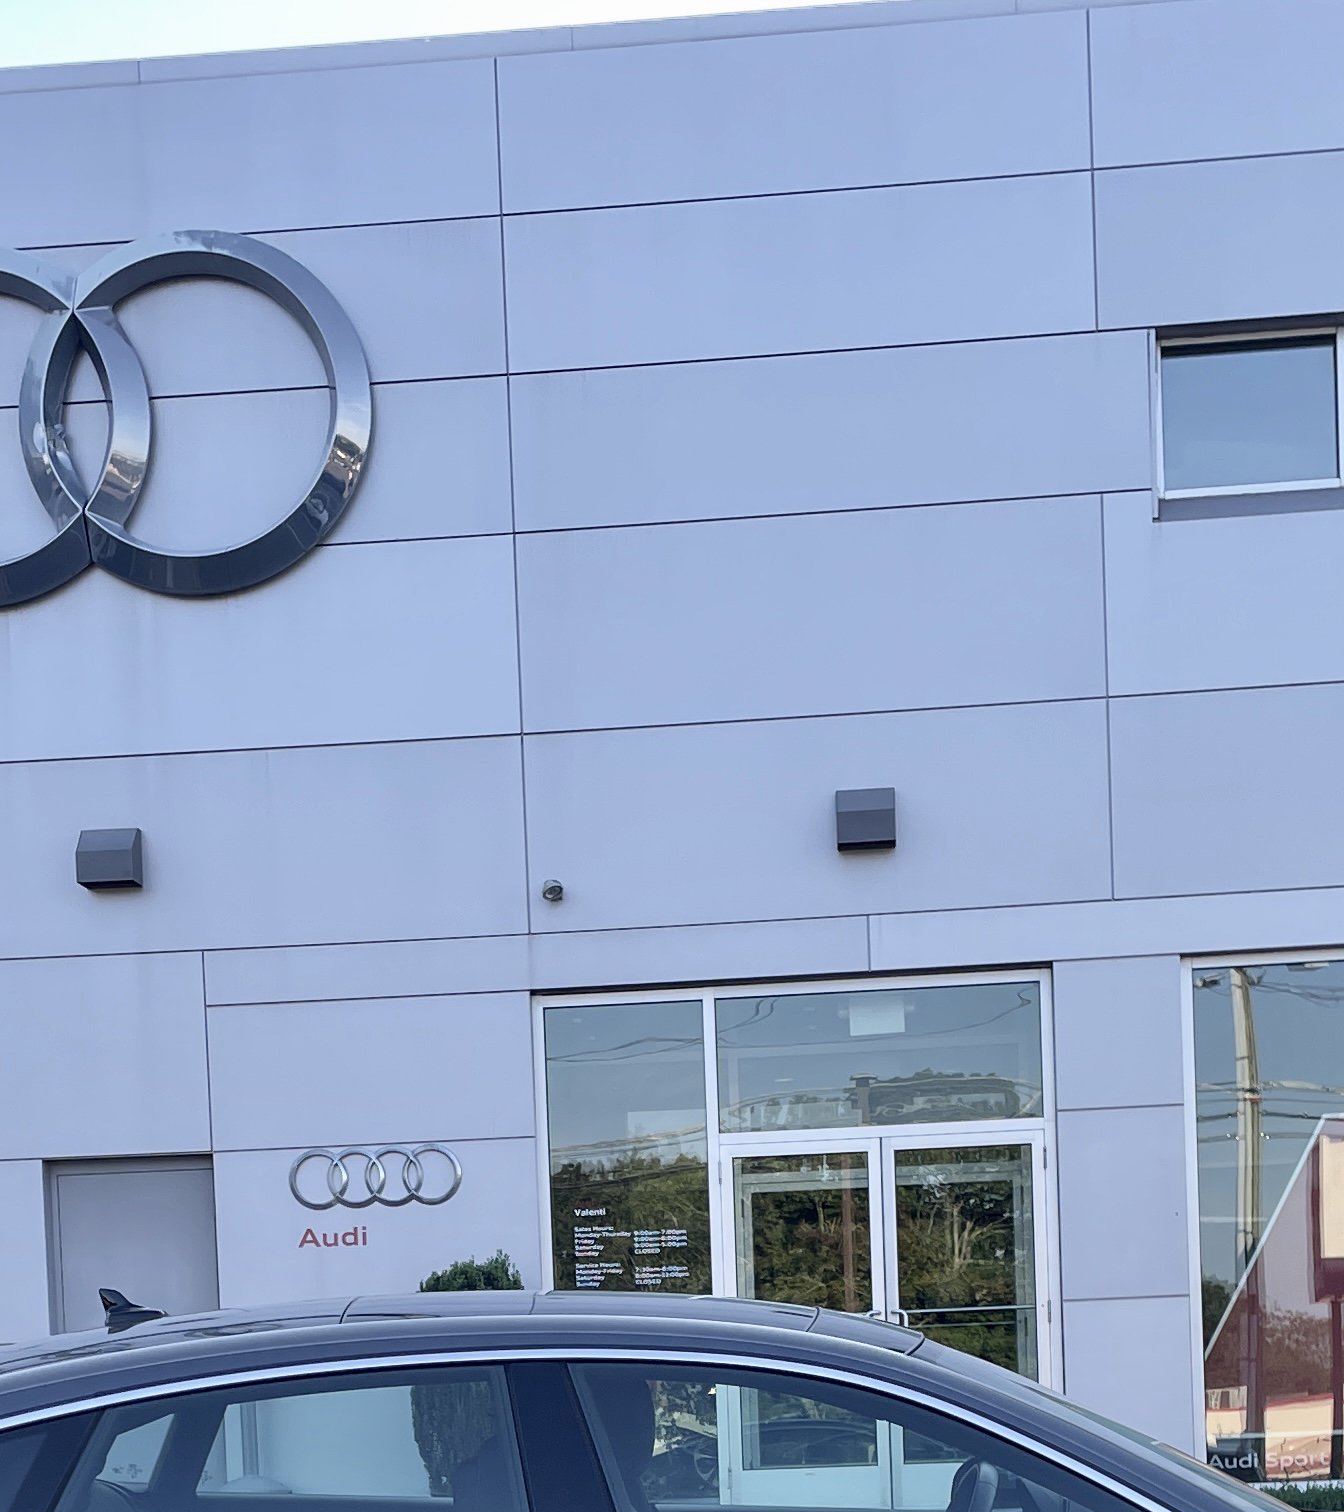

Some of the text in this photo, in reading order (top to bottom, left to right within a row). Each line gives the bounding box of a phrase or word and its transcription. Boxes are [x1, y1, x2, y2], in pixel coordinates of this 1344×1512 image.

[574, 1208, 606, 1217] Valenti
[298, 1226, 368, 1248] Audi
[1209, 1452, 1330, 1470] Audi Sport
